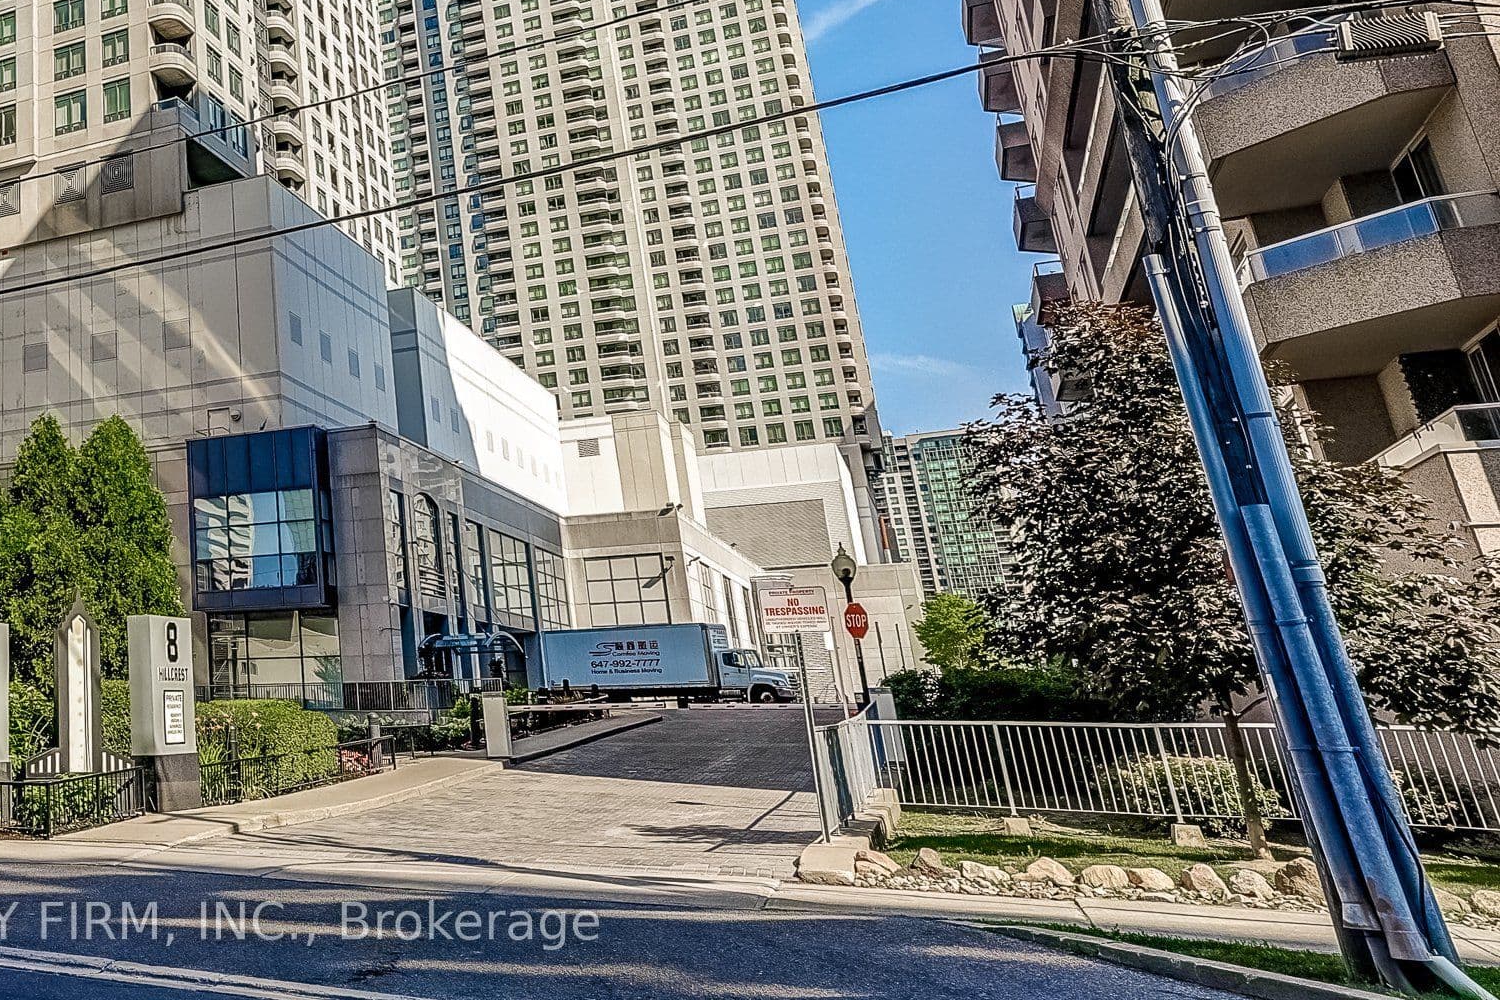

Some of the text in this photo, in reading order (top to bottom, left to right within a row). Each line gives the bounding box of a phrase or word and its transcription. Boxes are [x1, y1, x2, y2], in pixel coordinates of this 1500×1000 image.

[787, 598, 800, 607] NO
[764, 606, 826, 616] TRESPASSING
[846, 614, 867, 628] STOP
[167, 622, 178, 662] 8
[590, 659, 661, 669] 647-992-7777
[158, 667, 188, 682] HILLCREST
[166, 694, 182, 702] PRIVATE
